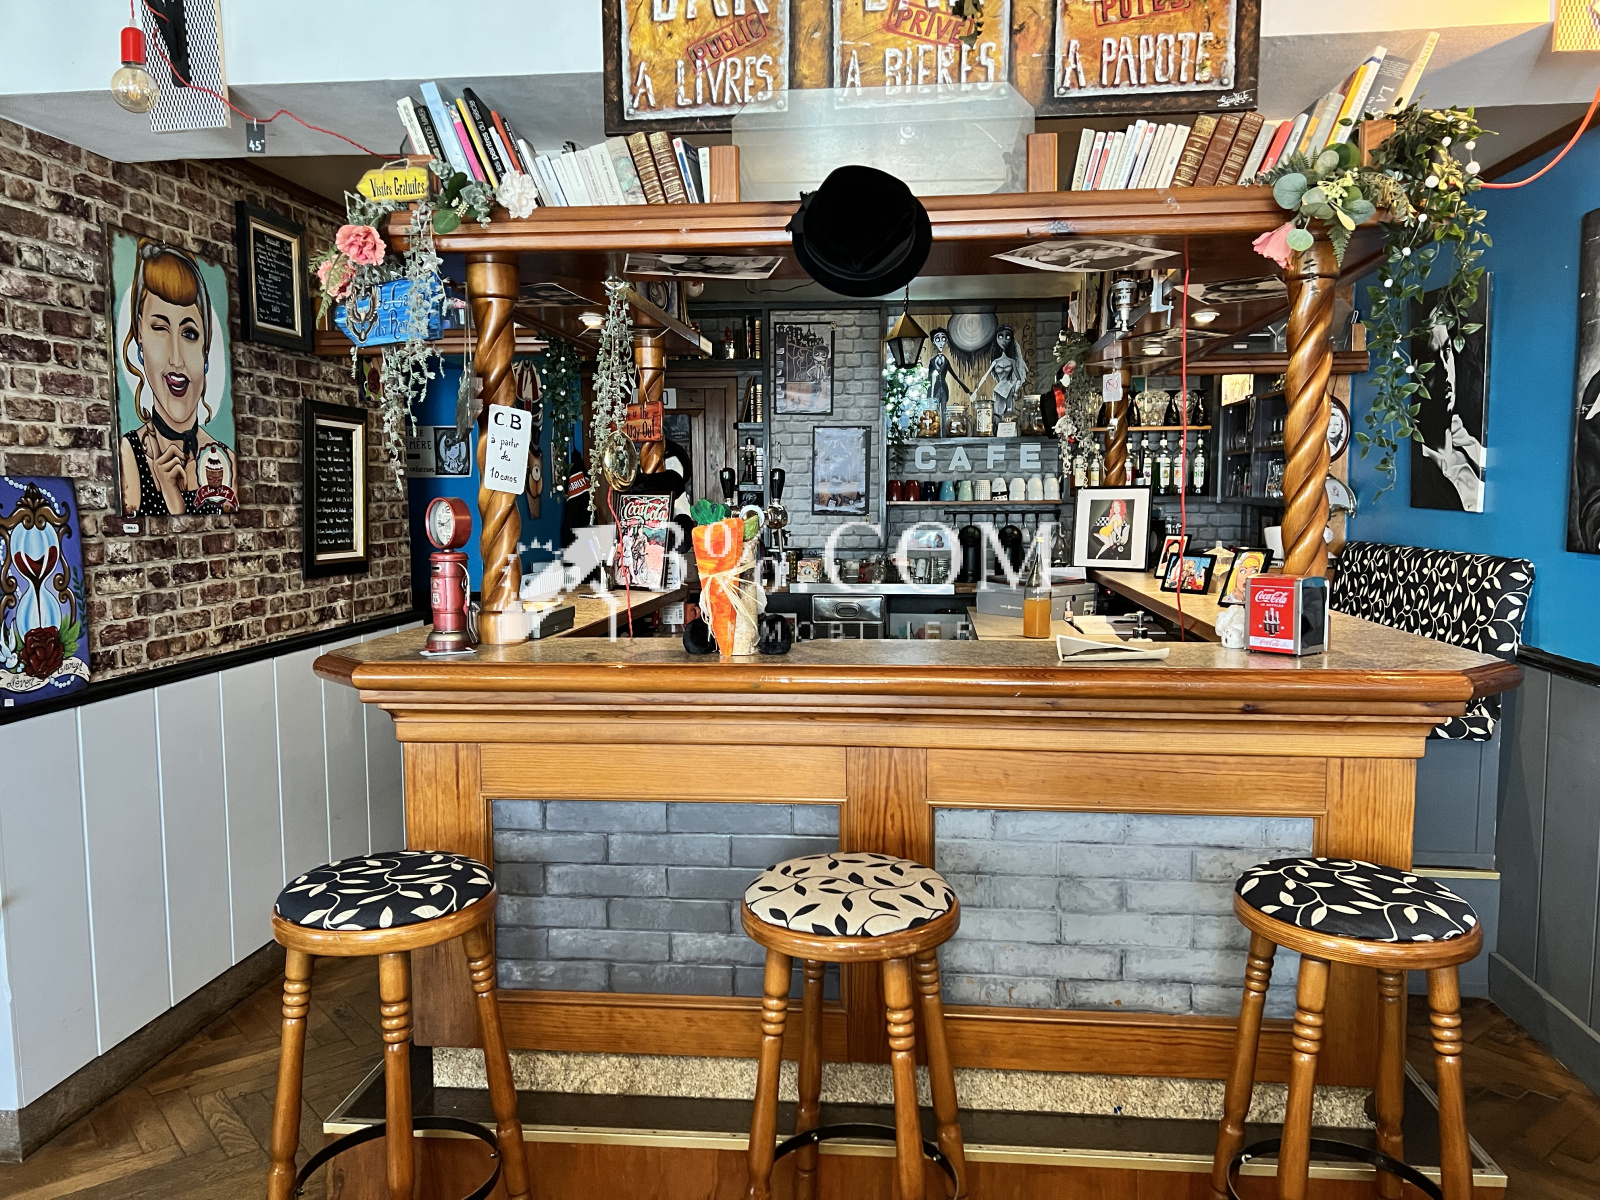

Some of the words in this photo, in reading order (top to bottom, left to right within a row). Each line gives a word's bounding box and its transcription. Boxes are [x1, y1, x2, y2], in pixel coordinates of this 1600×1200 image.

[692, 14, 763, 66] PUBLIC
[842, 49, 863, 97] A
[884, 40, 997, 96] BIERES
[1063, 39, 1086, 88] A
[1101, 32, 1214, 86] PAPOTE
[632, 61, 656, 109] A
[675, 54, 774, 106] LIVRES
[476, 120, 486, 131] du
[480, 131, 499, 160] peintres
[1249, 132, 1268, 164] Sculpture
[494, 160, 503, 172] les
[369, 178, 393, 198] Visites
[394, 176, 425, 197] Gratuites
[500, 438, 520, 451] partir
[501, 450, 511, 462] de
[914, 442, 1042, 471] CAFE
